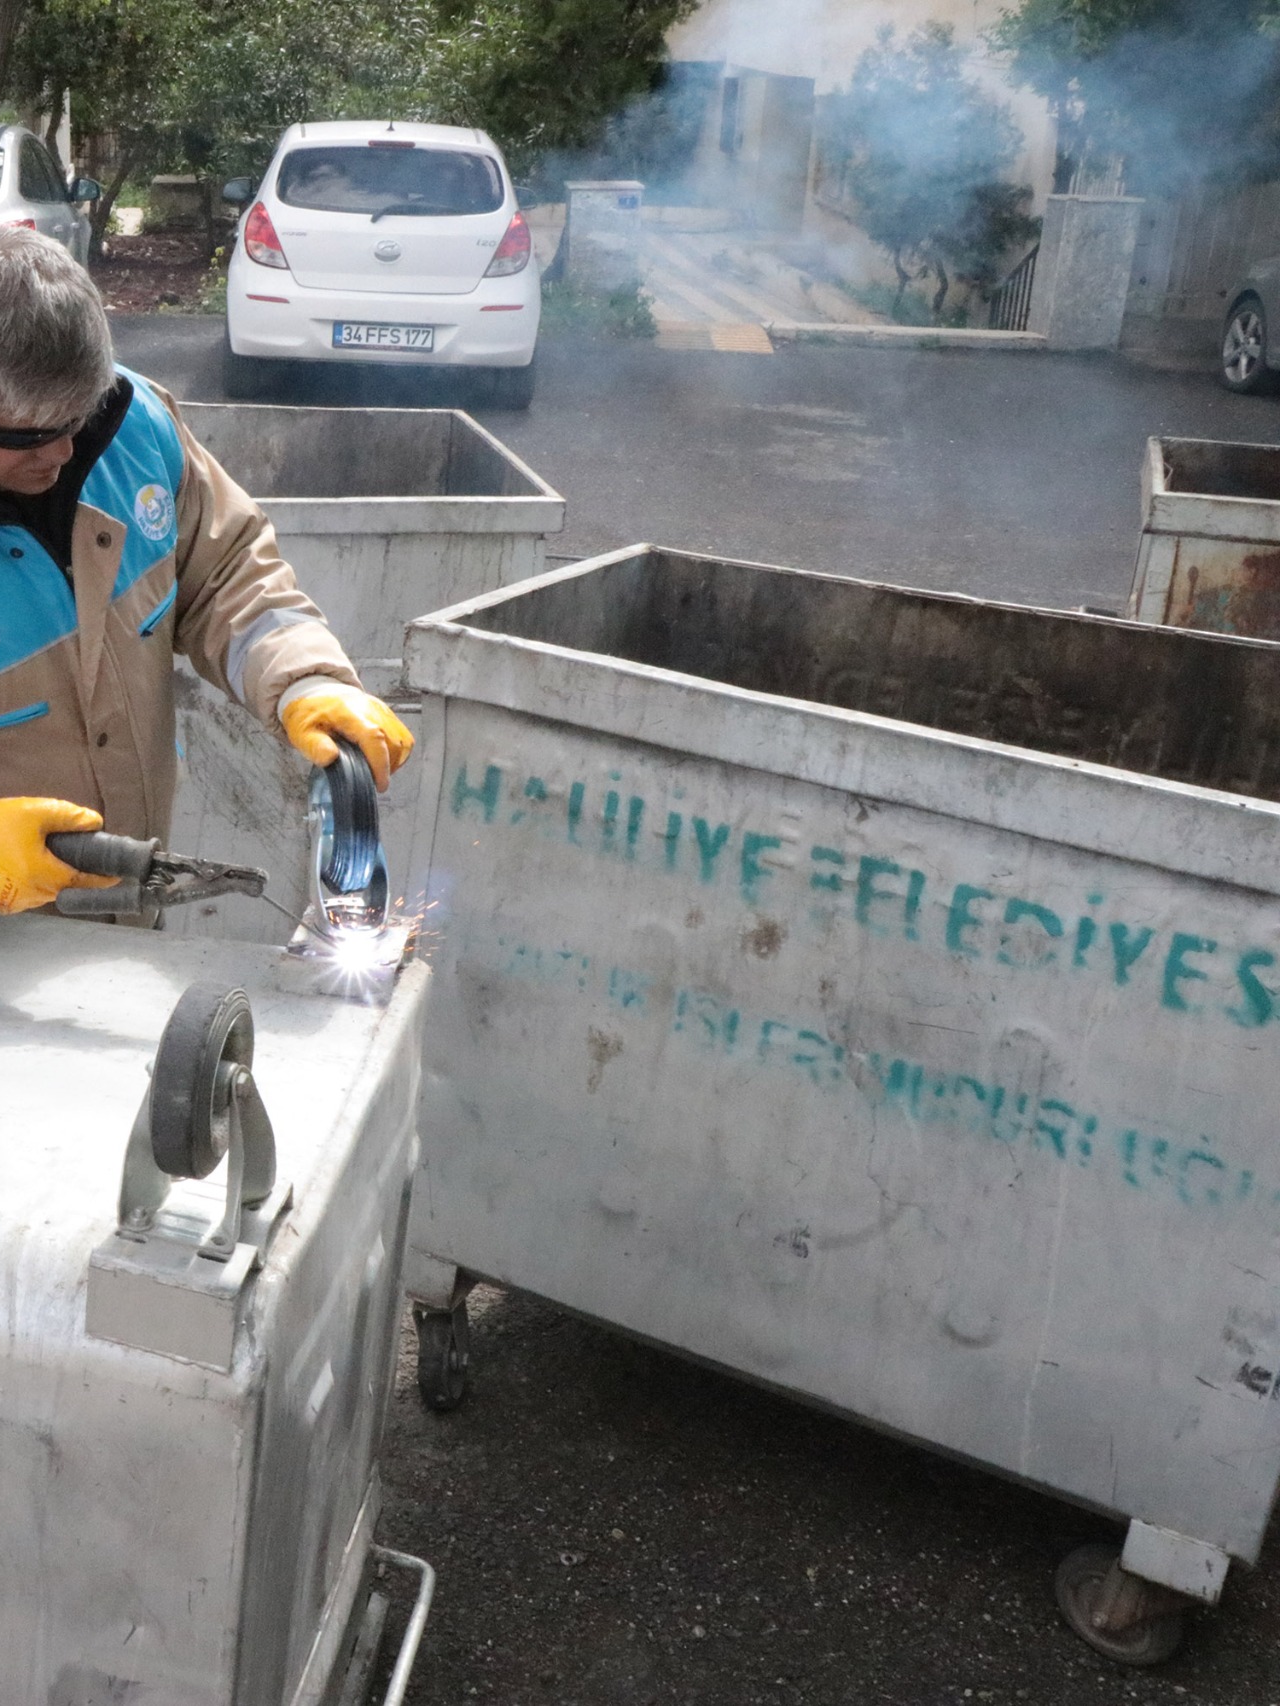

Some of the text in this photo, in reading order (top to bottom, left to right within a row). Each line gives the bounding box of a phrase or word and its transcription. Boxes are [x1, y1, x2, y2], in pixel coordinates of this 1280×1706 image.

[343, 326, 432, 346] 34 FFS 177
